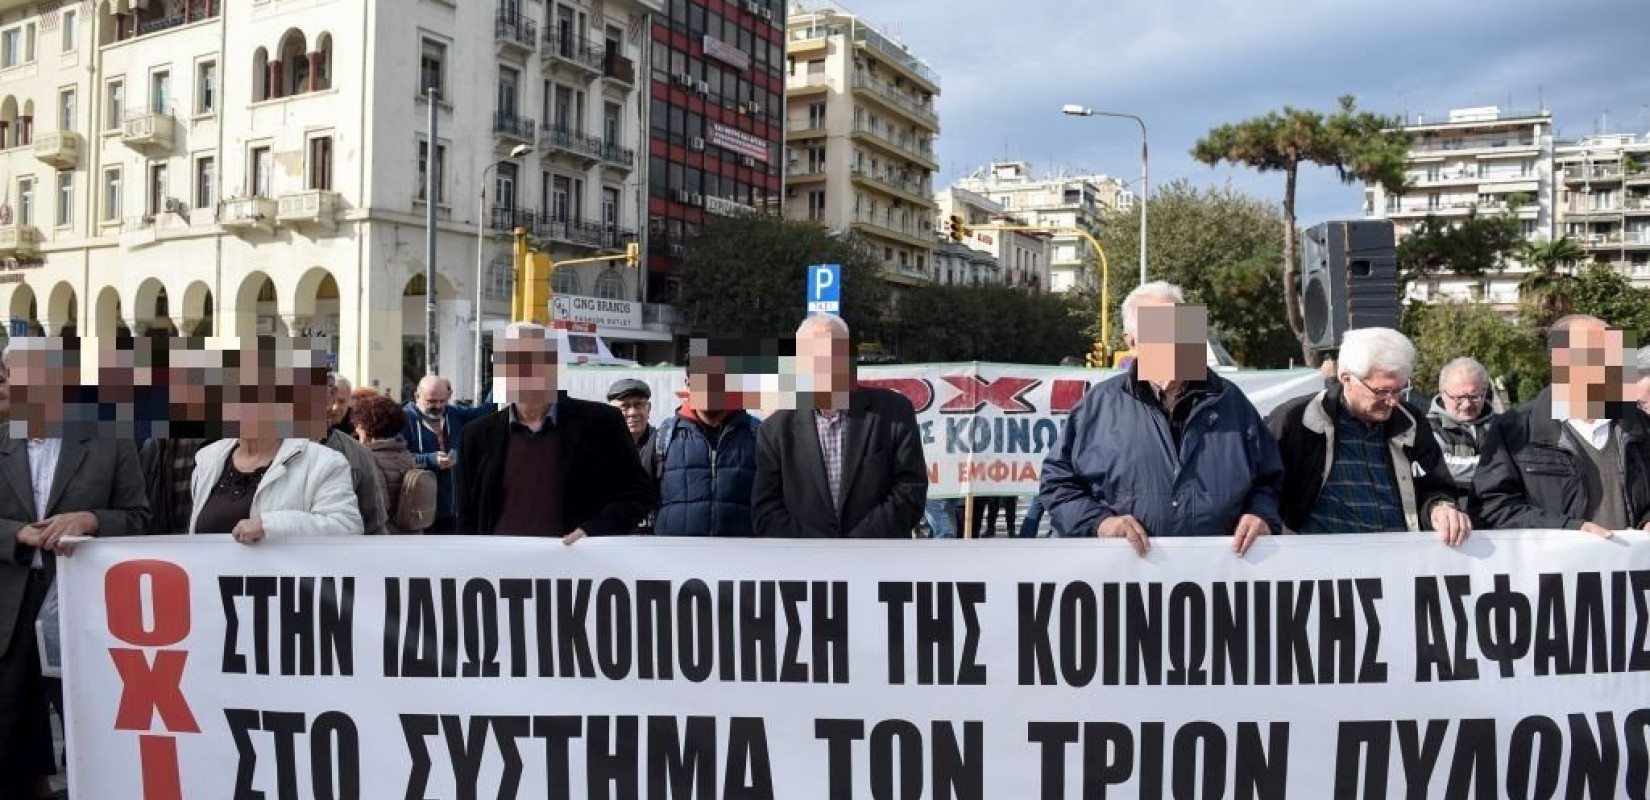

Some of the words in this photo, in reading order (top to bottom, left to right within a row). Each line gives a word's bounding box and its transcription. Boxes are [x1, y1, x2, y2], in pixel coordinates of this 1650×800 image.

[597, 301, 631, 314] BRANDS
[816, 269, 833, 300] P
[945, 416, 1068, 454] ΚΟΙΝΩ
[218, 576, 355, 676] ΣΤΗΝ
[383, 576, 850, 684] ΙΔΙΩΤΙΚΟΠΟΙΗΣΗ
[878, 581, 987, 686] ΤΗΣ
[1017, 578, 1388, 688] ΚΟΙΝΩΝΙΚΗΣ
[104, 559, 201, 800] ΟΧΙ
[223, 708, 360, 800] ΣΤΟ
[398, 713, 774, 800] ΣΥΣΤΗΜΑ
